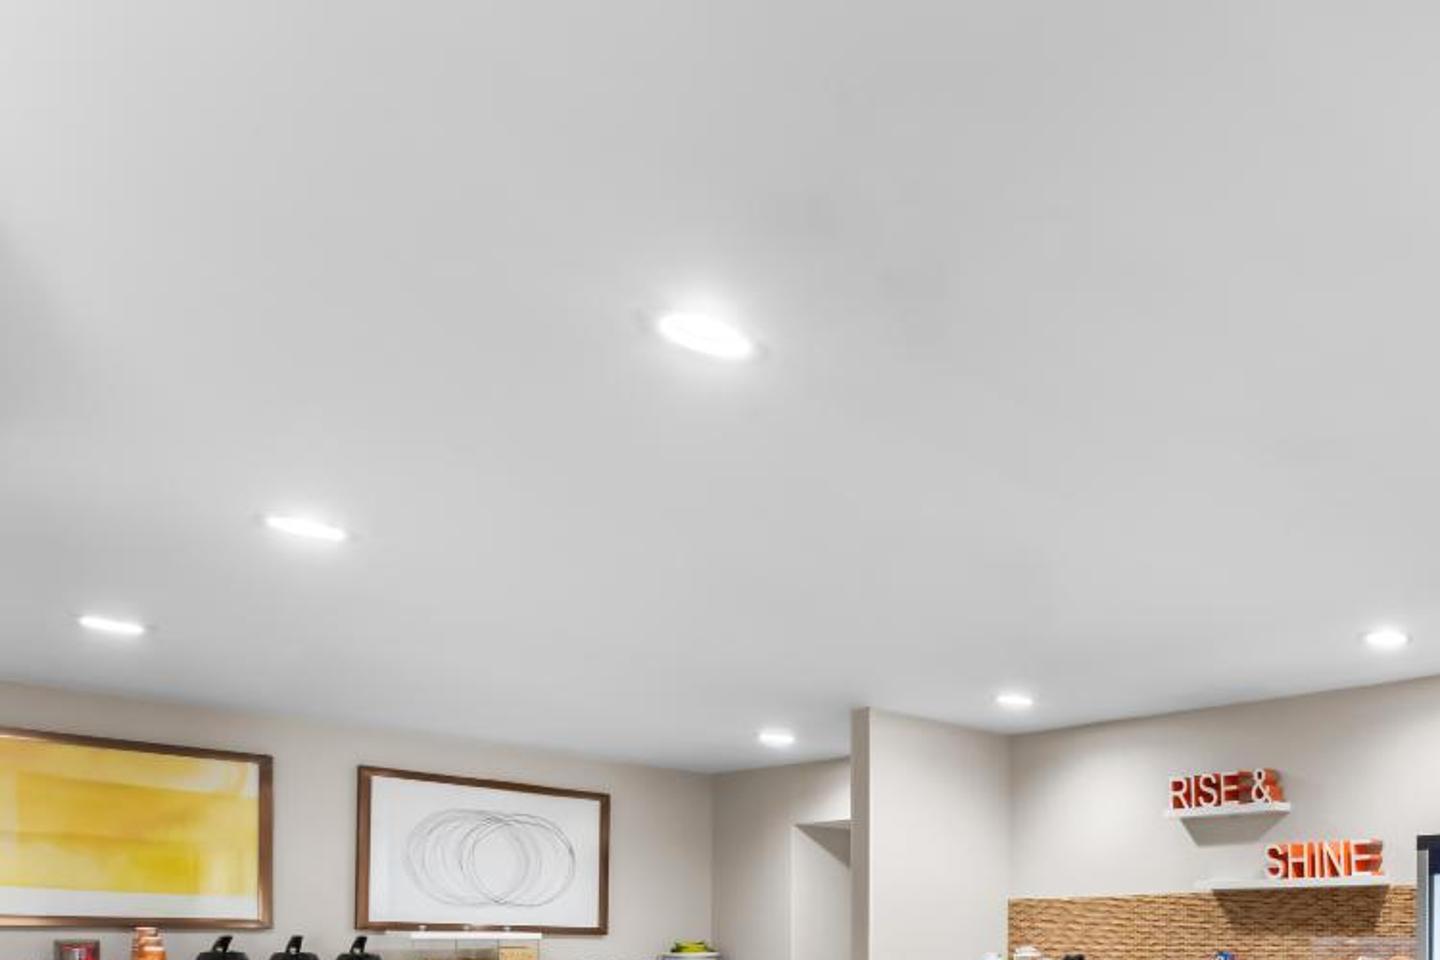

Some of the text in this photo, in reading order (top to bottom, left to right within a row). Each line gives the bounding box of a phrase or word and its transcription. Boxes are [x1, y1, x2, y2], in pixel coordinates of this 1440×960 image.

[1168, 768, 1272, 809] RISE &
[1264, 839, 1376, 880] SHINE
